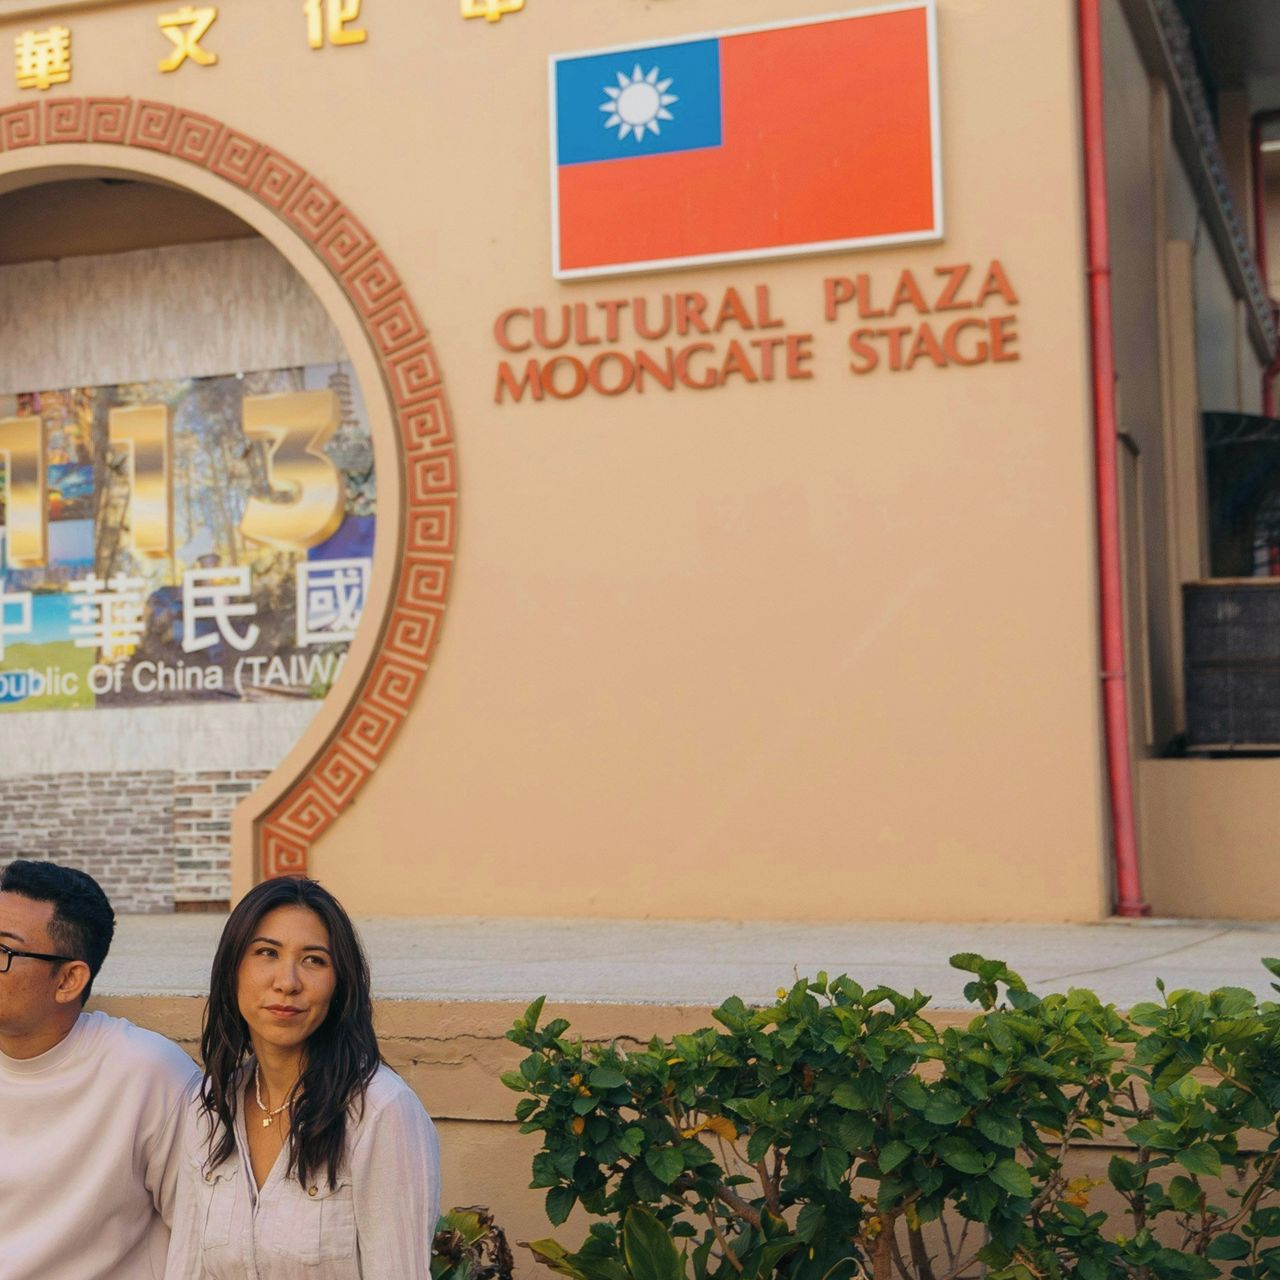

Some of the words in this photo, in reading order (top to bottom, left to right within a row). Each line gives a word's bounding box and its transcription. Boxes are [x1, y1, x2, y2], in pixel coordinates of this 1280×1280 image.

[493, 283, 784, 354] CULTURAL
[823, 260, 1019, 322] PLAZA
[494, 333, 814, 405] MOONGATE
[847, 315, 1021, 375] STAGE
[86, 661, 127, 695] Of
[131, 659, 223, 693] China
